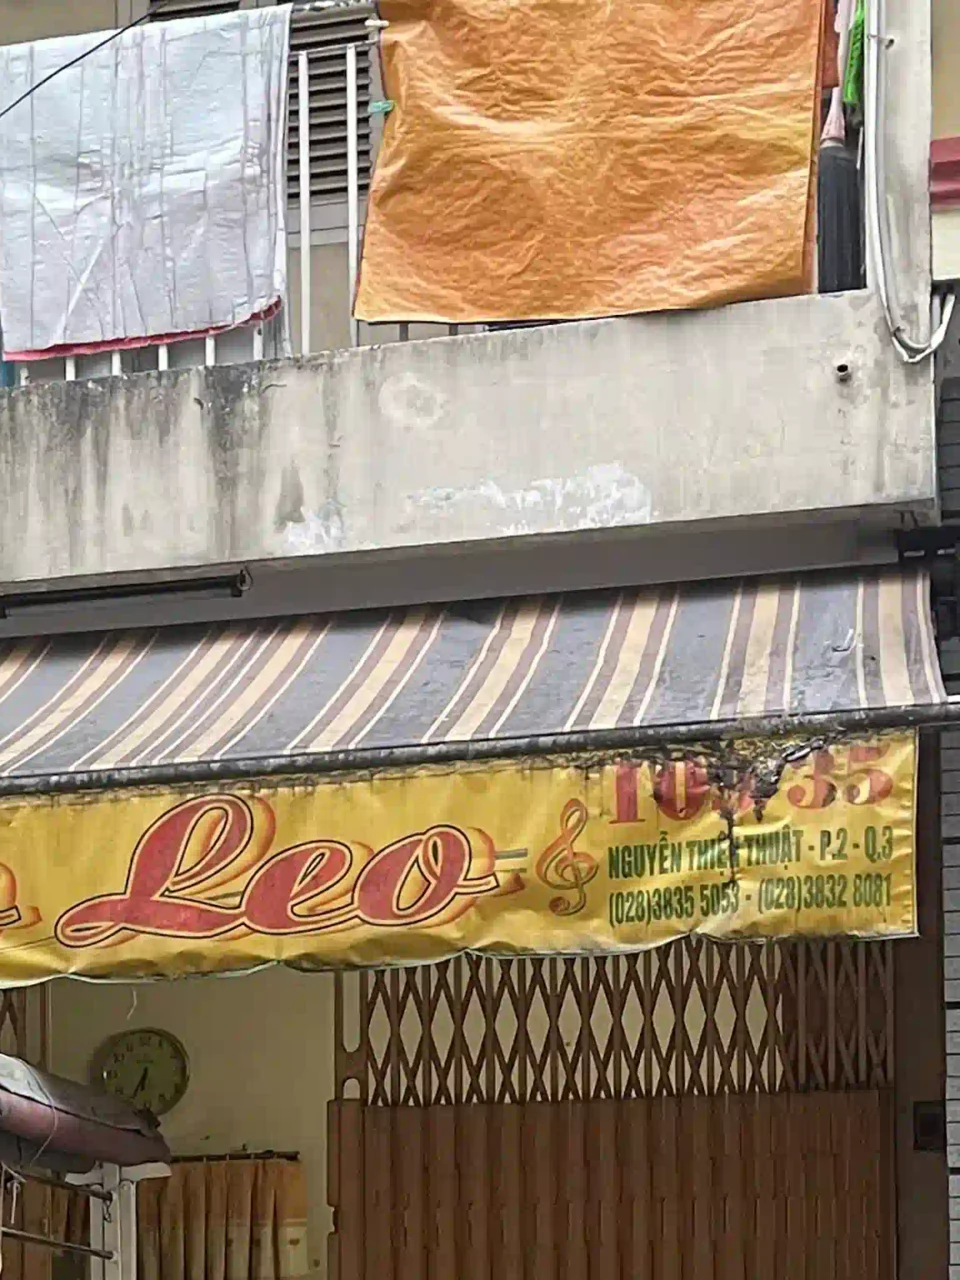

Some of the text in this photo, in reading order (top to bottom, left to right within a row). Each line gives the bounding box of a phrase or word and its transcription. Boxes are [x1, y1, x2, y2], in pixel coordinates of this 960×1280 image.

[54, 793, 500, 948] Leo
[607, 829, 682, 879] NGUYỄN
[743, 823, 804, 871] THUẬT
[820, 827, 848, 861] P.2
[864, 825, 894, 864] Q.3
[608, 888, 695, 929] (028)3835
[758, 874, 848, 915] (028)3832
[853, 872, 893, 908] 8081
